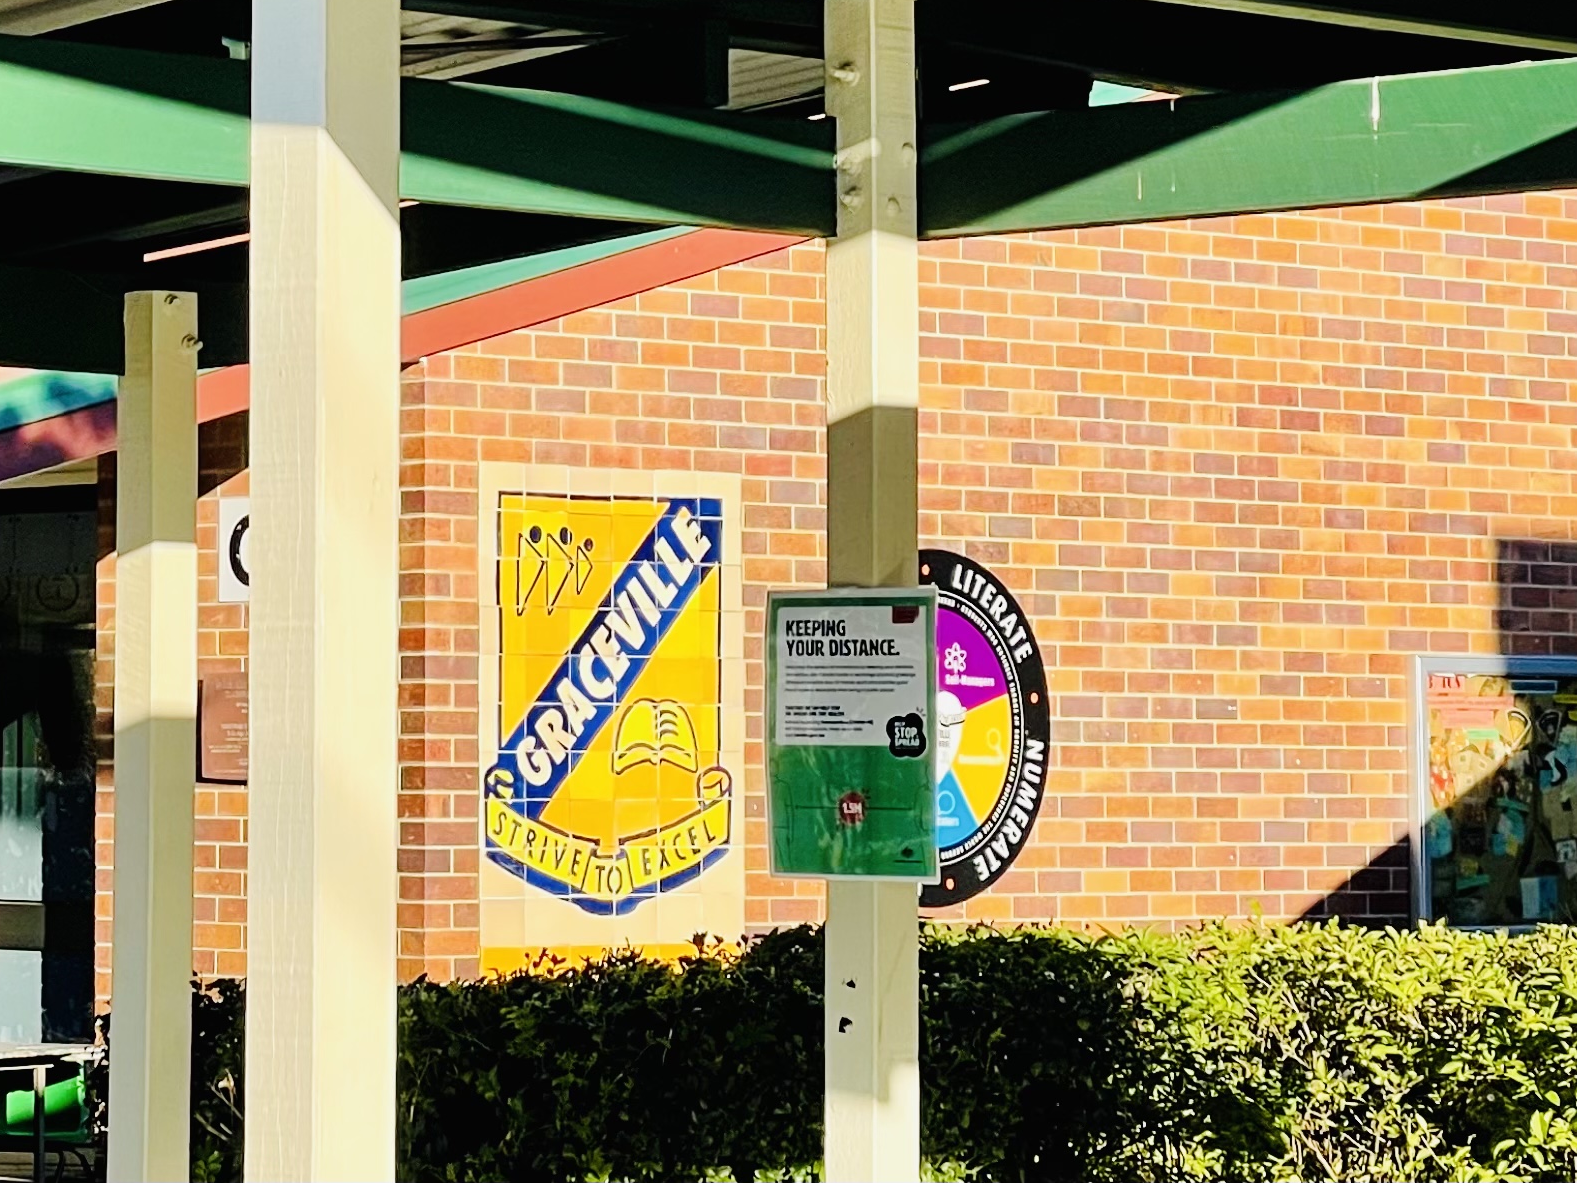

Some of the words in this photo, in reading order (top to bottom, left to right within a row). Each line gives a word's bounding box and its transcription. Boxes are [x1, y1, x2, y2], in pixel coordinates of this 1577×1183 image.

[515, 506, 712, 787] GRACEVILLE
[785, 619, 846, 637] KEEPING
[786, 639, 825, 657] YOUR
[829, 639, 900, 657] DISTANCE.
[952, 563, 1033, 664] LITERATE
[493, 811, 582, 878] STRIVE
[595, 865, 623, 895] TO
[642, 819, 716, 876] EXCEL
[973, 738, 1045, 882] NUMERATE
